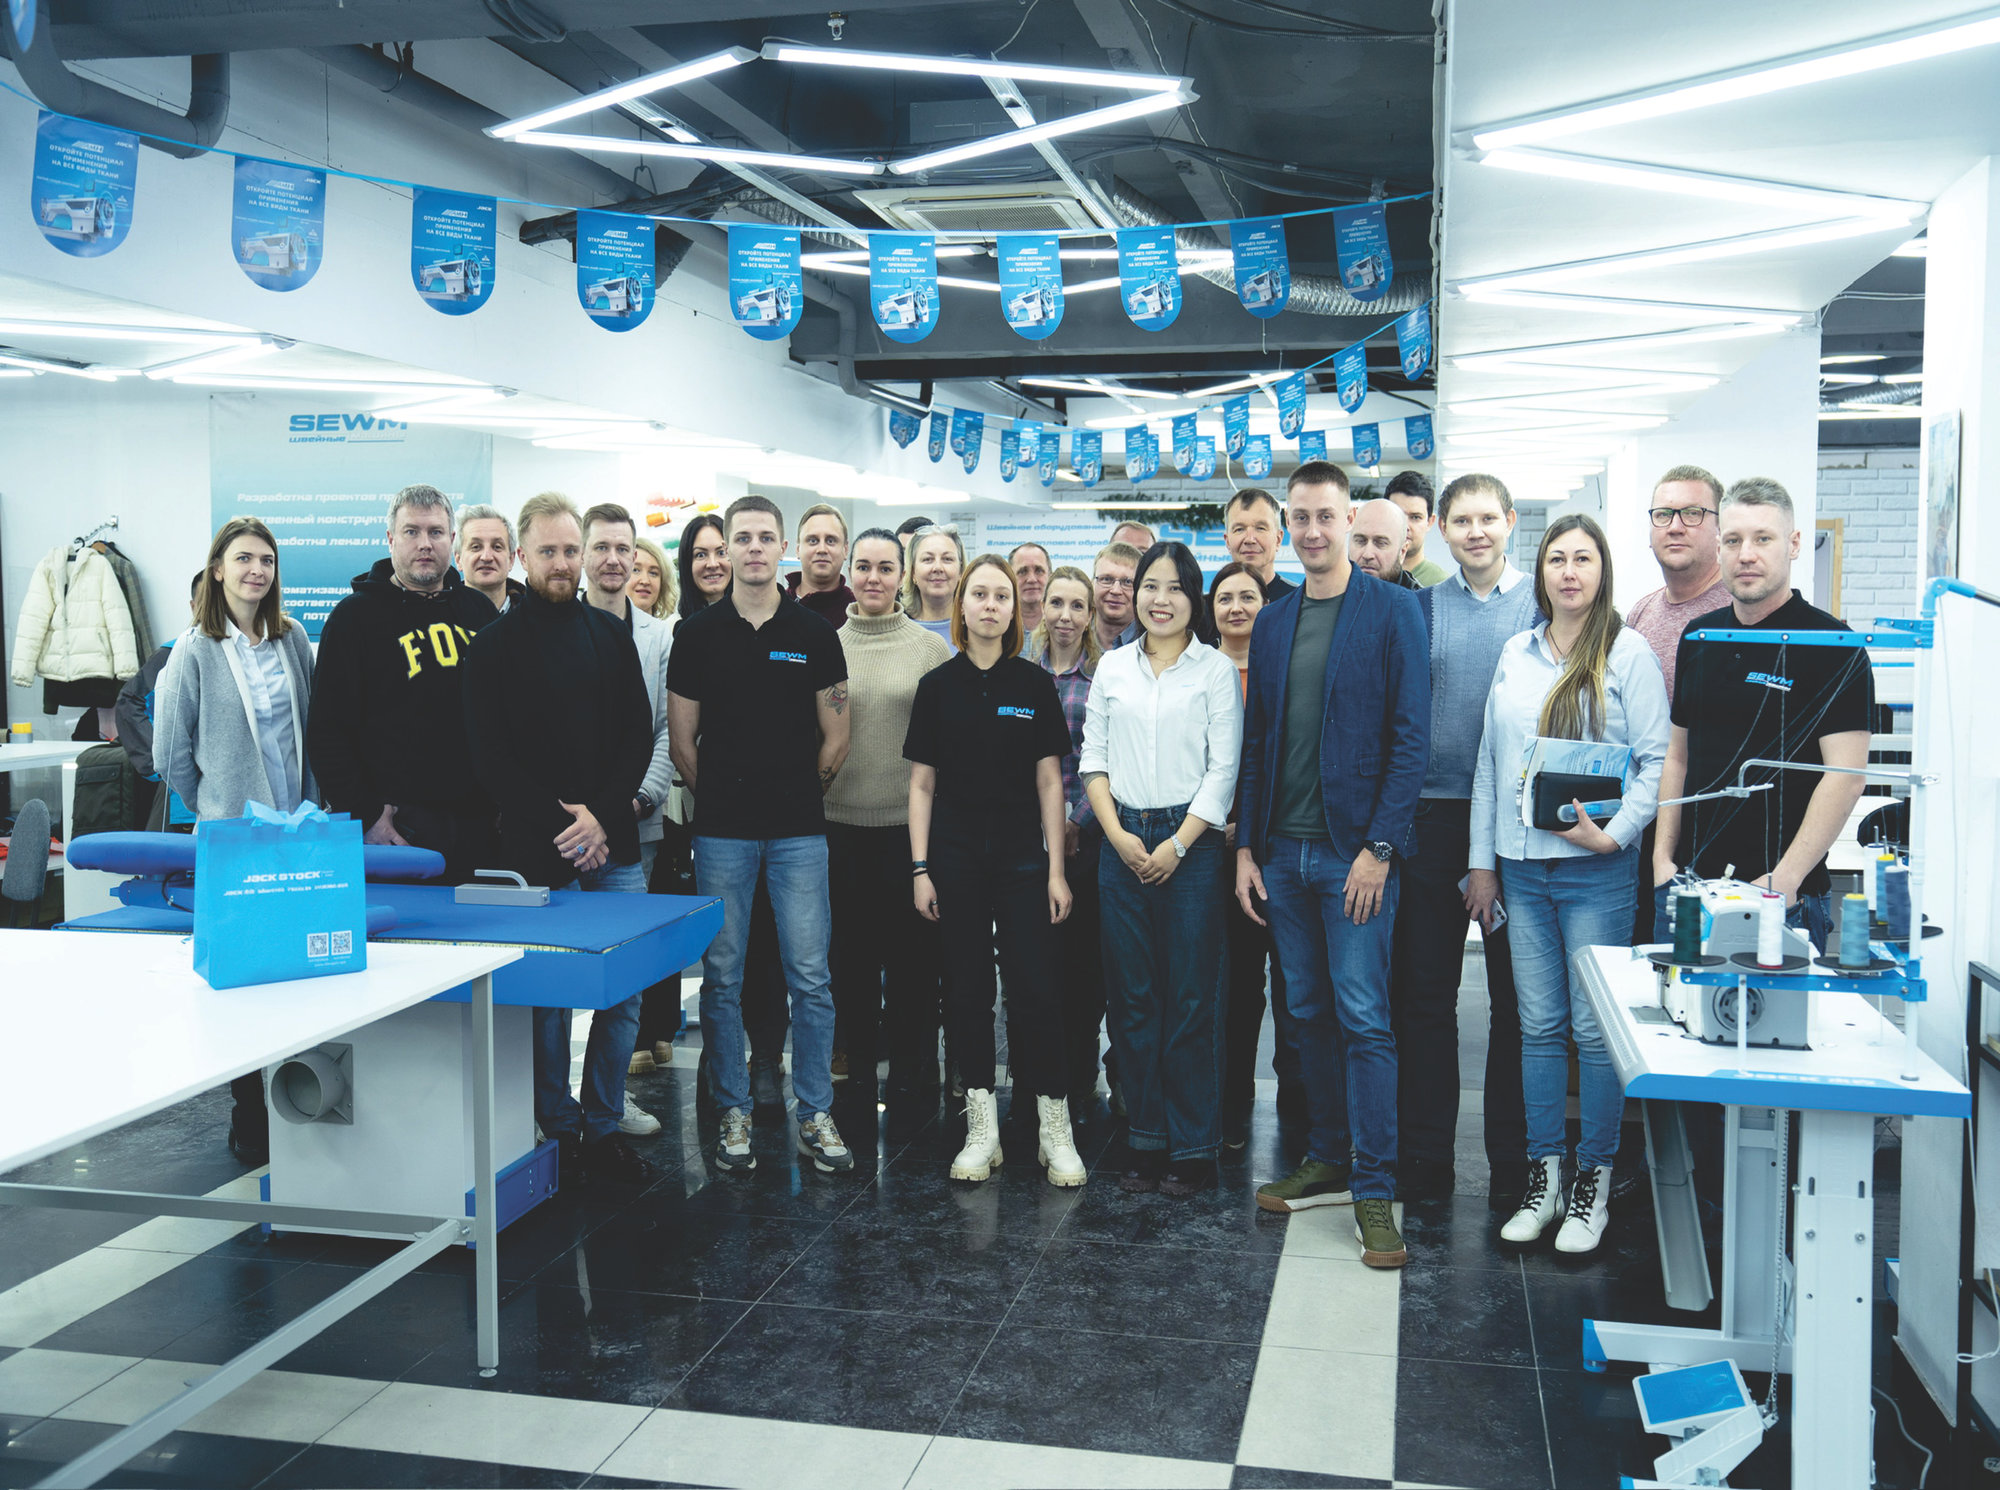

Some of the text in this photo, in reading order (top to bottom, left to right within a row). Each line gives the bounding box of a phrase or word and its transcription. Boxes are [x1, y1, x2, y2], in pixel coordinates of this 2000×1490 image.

[49, 144, 124, 166] ОТКРОЙТЕ ПОТЕНЦИАЛ
[63, 155, 108, 169] ПРИМЕНЕНИЯ
[51, 159, 119, 179] НА ВСЕ ВИДЫ ТКАНИ
[246, 185, 276, 195] ОТКРОЙТЕ
[277, 191, 313, 202] ПОТЕНЦИАЛ
[258, 194, 299, 206] ПРИМЕНЕНИЯ
[270, 203, 289, 211] ВИДЫ
[289, 207, 310, 215] ТКАНИ
[446, 231, 463, 239] ВИДЫ
[289, 413, 408, 431] SEWM
[289, 434, 346, 443] швейные
[237, 492, 313, 504] Разработка
[315, 493, 380, 504] проектов
[275, 536, 327, 546] работка
[329, 538, 370, 546] лекал
[371, 538, 381, 546] и
[1746, 671, 1794, 687] SEWM
[243, 873, 278, 883] JACK
[278, 871, 321, 881] STOCK
